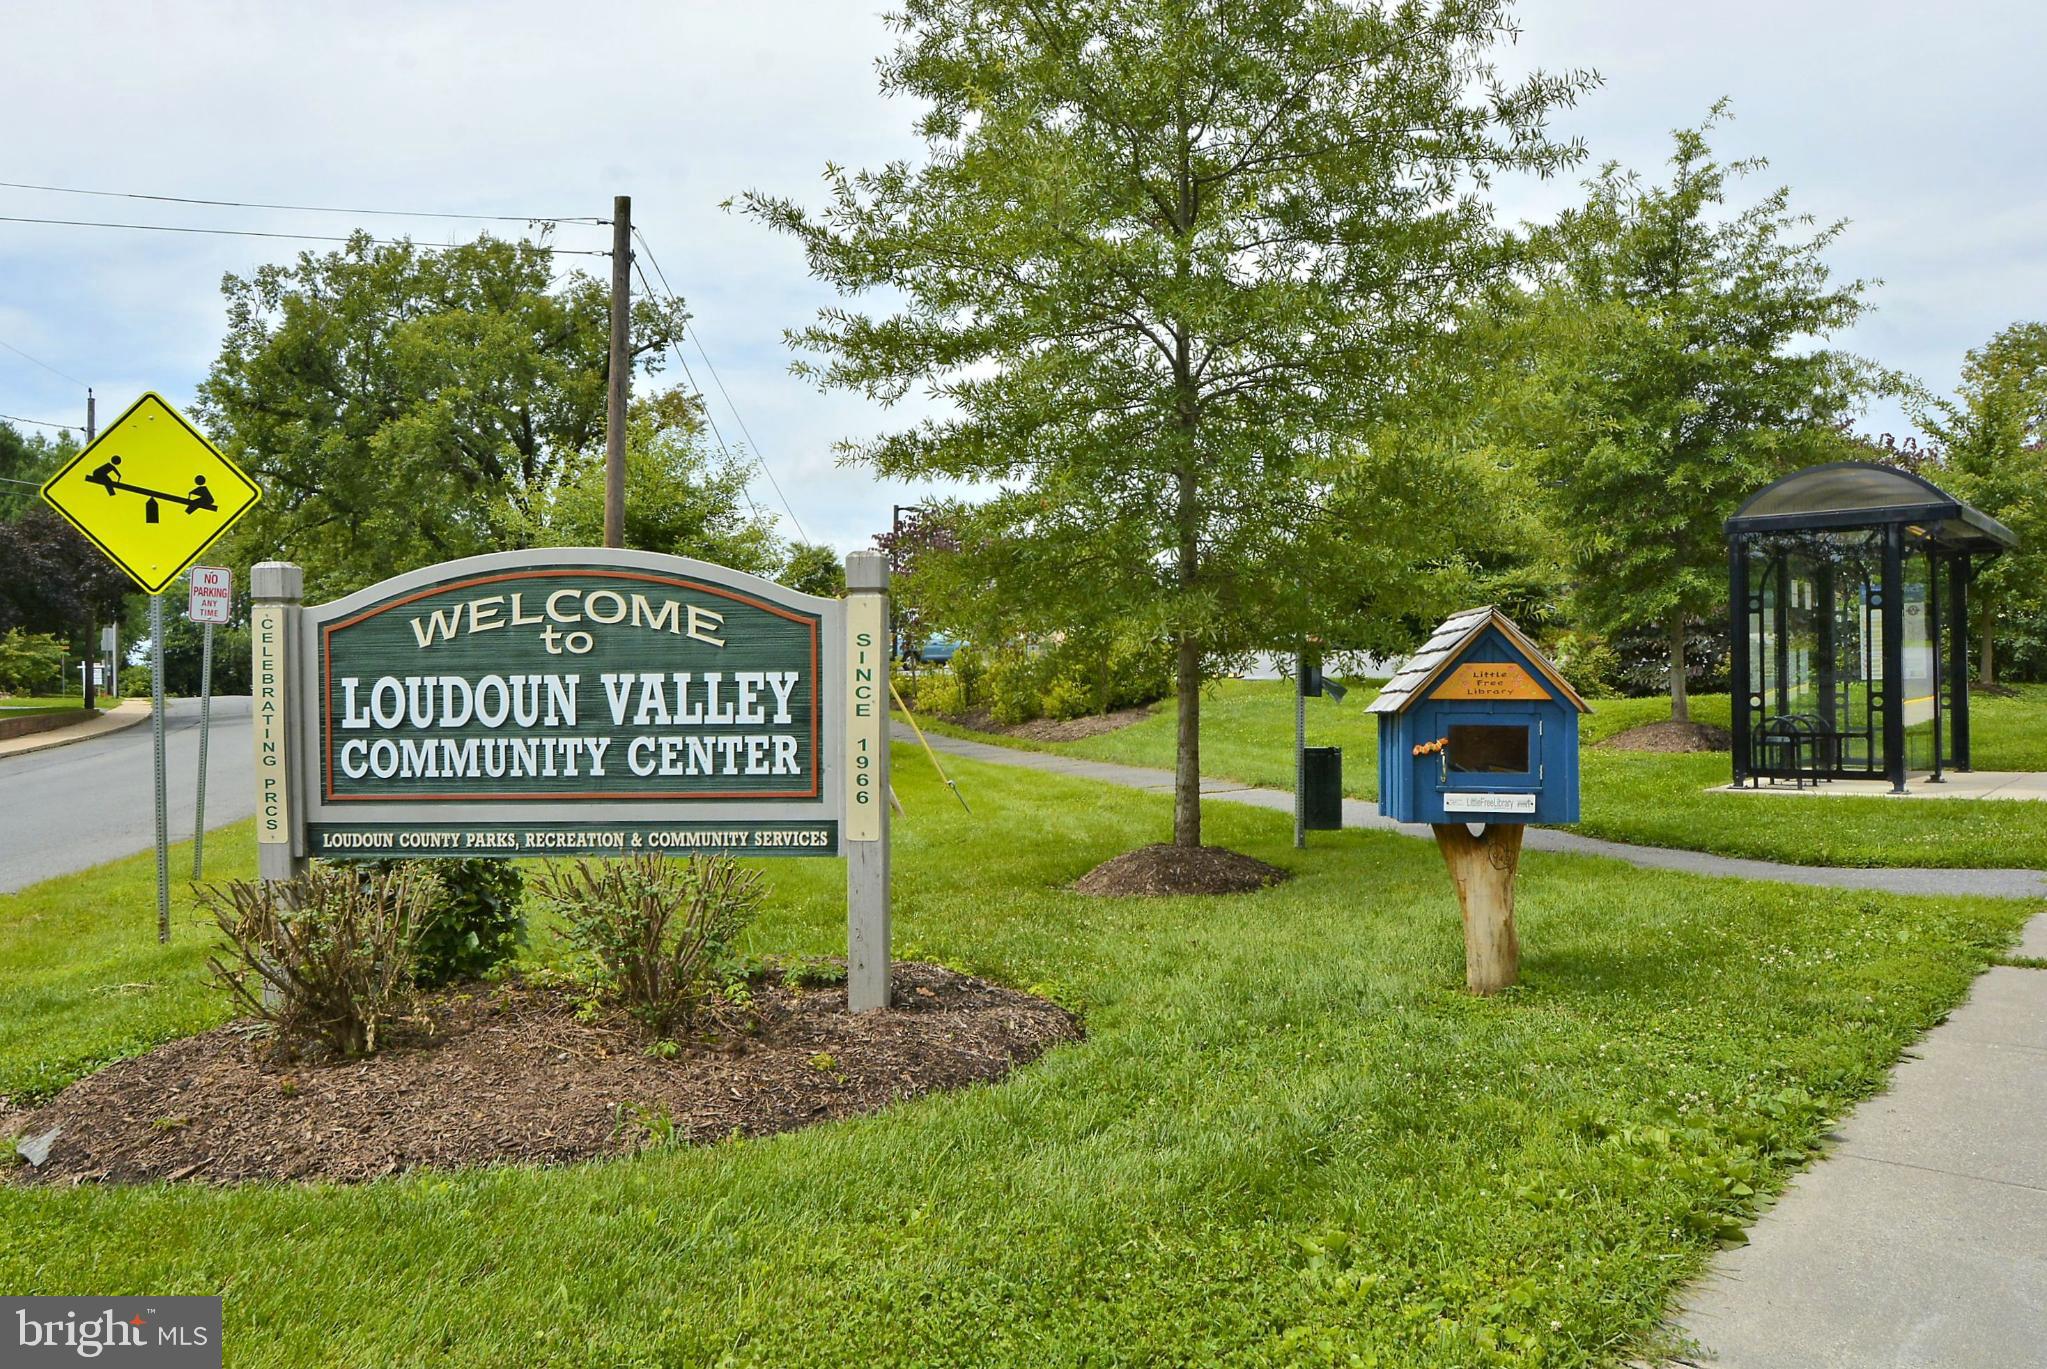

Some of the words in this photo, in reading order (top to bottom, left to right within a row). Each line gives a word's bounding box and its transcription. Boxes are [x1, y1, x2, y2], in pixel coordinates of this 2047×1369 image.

[194, 587, 227, 598] PARKING
[204, 574, 218, 584] NO
[200, 609, 218, 617] TIME
[410, 589, 725, 649] WELCOME
[539, 624, 593, 654] to
[261, 618, 276, 766] CELEBRATING
[855, 633, 872, 717] SINCE
[341, 674, 580, 729] LOUDOUN
[601, 671, 799, 726] VALLEY
[340, 736, 611, 779] COMMUNITY
[627, 735, 801, 777] CENTER
[856, 738, 869, 804] 1966
[264, 778, 278, 831] PRCS
[323, 833, 393, 848] LOUDOUN
[400, 832, 460, 848] COUNTY
[466, 832, 519, 850] PARKS,
[525, 831, 625, 848] RECREATION
[630, 831, 643, 847] &
[648, 831, 749, 848] COMMUNITY
[754, 831, 828, 847] SERVICES
